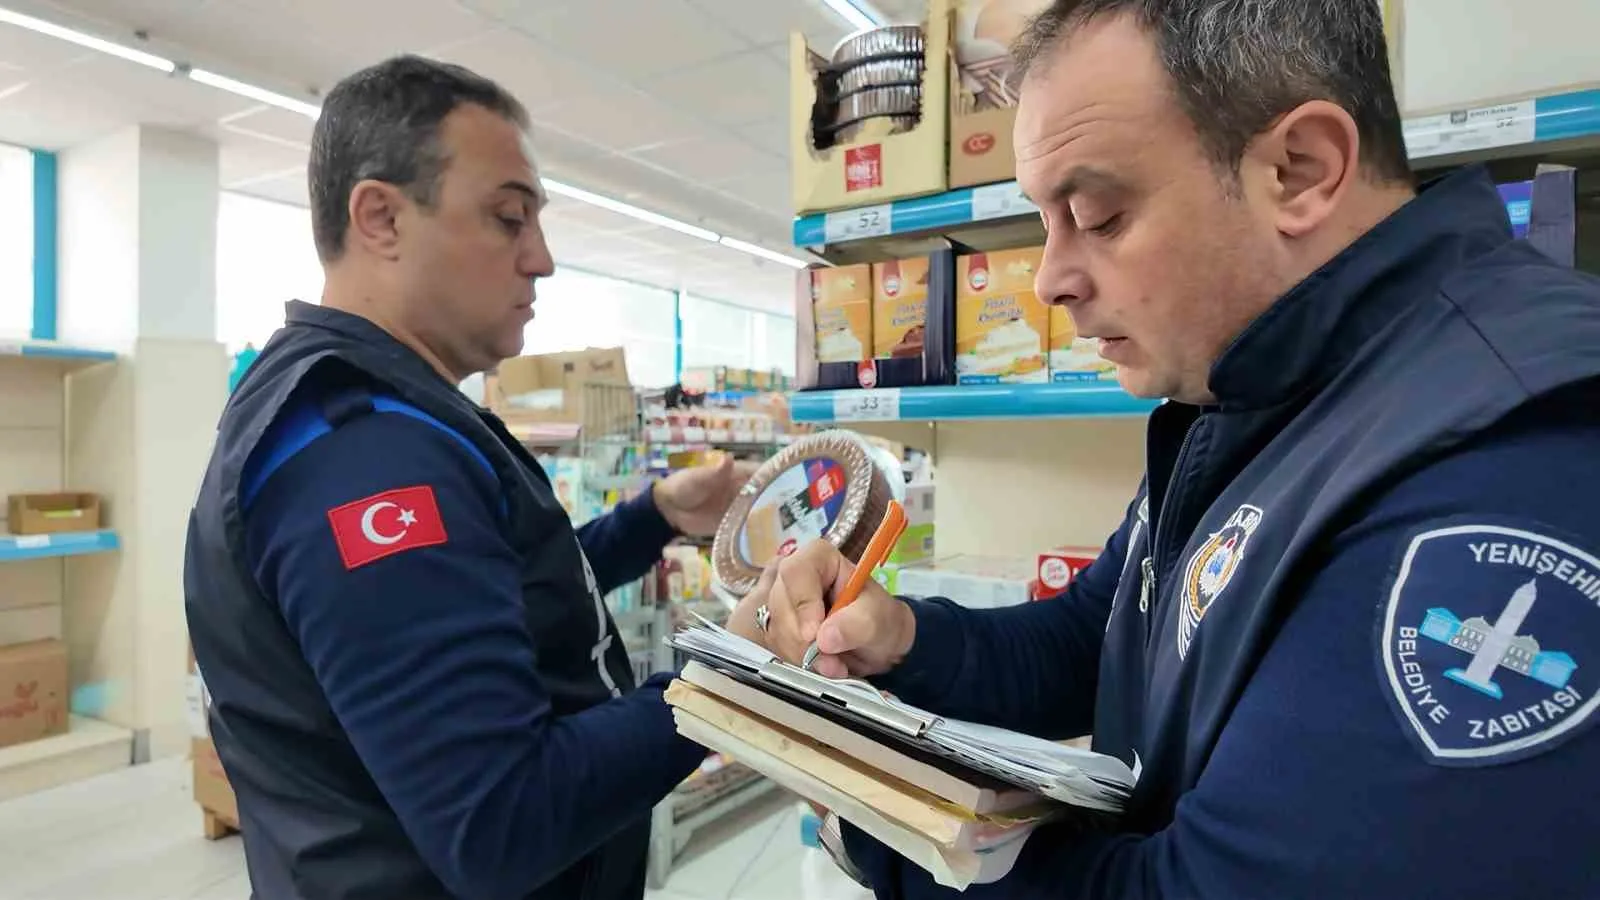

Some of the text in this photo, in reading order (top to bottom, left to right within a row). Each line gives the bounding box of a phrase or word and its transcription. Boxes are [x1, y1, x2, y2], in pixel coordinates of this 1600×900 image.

[858, 210, 881, 229] 52
[859, 396, 880, 411] 33
[1397, 626, 1451, 725] BELEDİYE
[1468, 685, 1582, 739] ZABITASI
